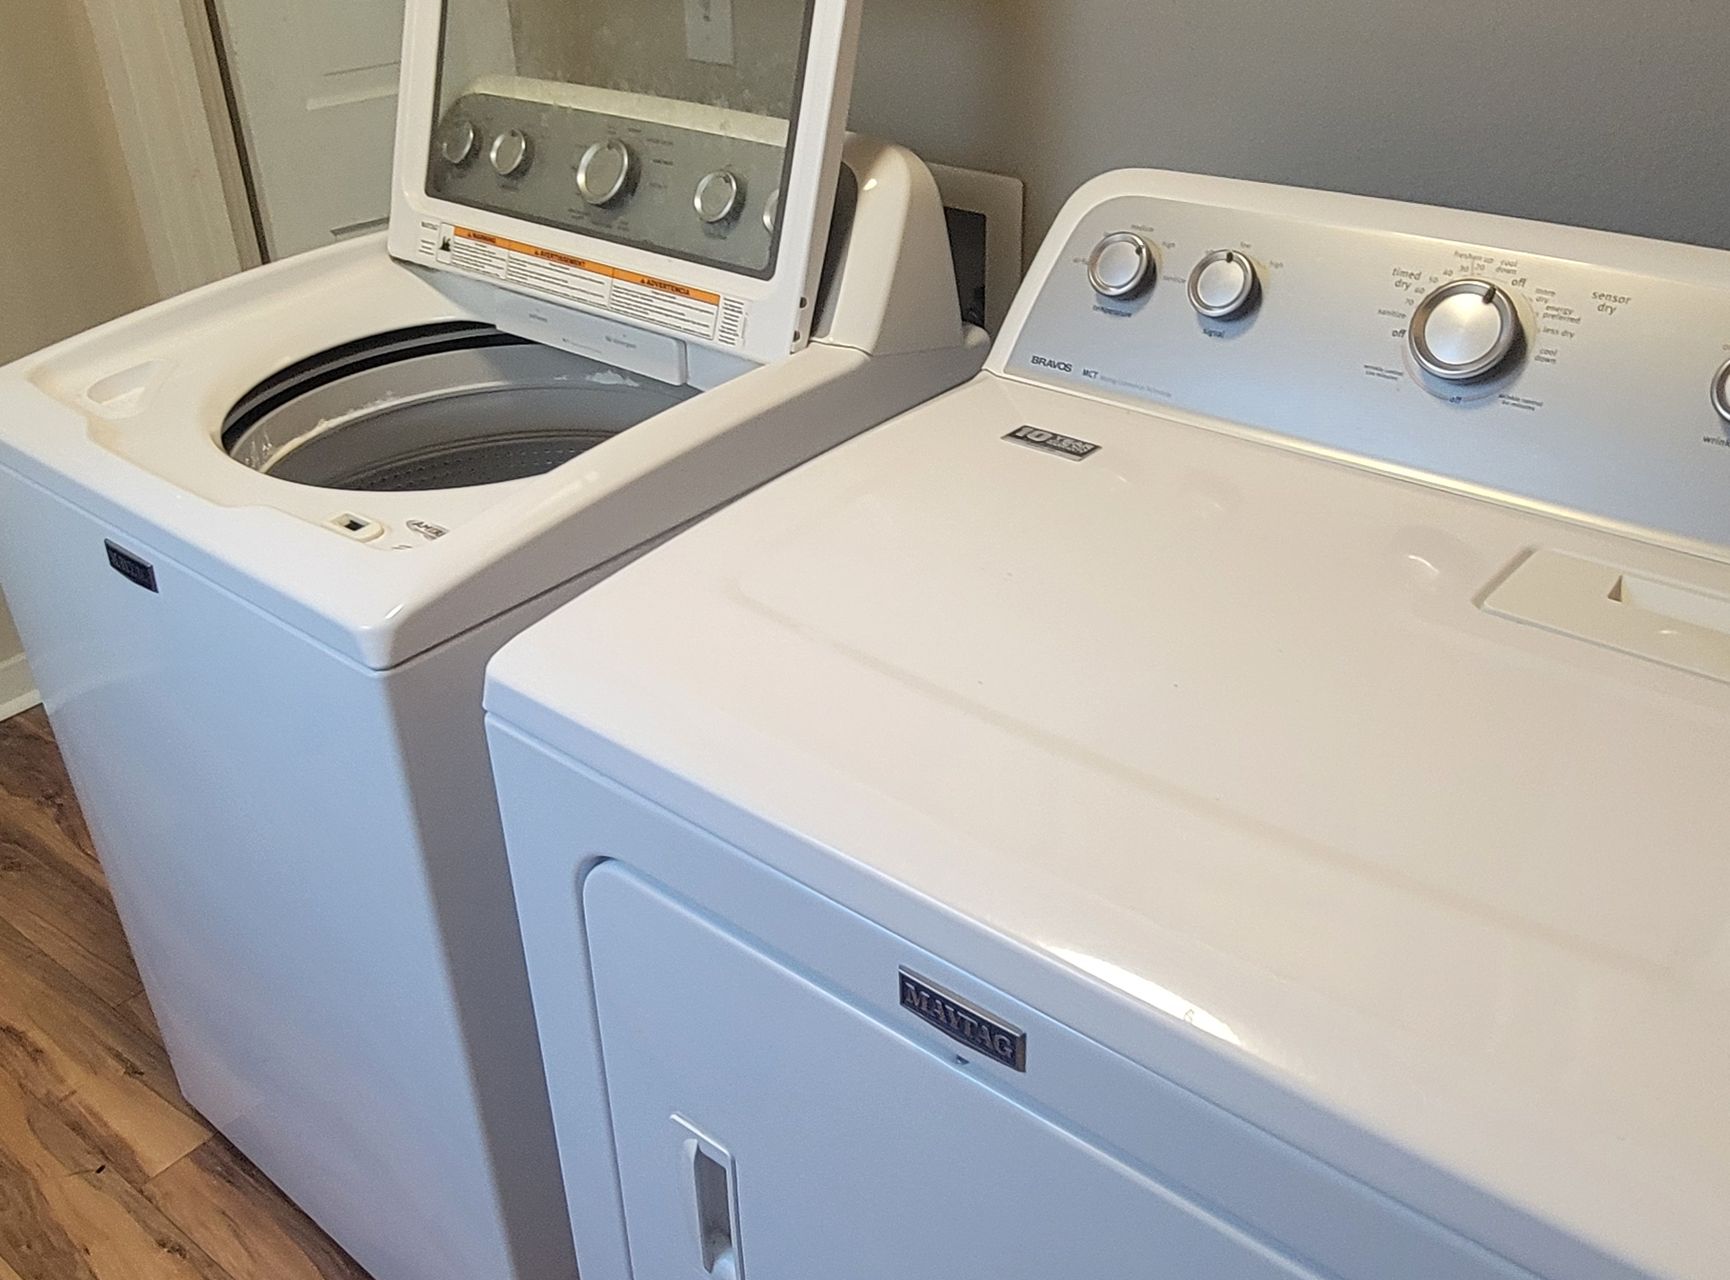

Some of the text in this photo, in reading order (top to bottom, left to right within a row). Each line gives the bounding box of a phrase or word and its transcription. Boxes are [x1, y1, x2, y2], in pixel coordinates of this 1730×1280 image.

[1391, 267, 1422, 281] timed
[647, 279, 691, 296] ADVERTENCIA
[1394, 279, 1412, 291] dry
[1511, 278, 1527, 288] off
[1591, 291, 1632, 305] sensor
[1545, 305, 1575, 316] energy
[1597, 303, 1617, 316] dry
[1542, 312, 1582, 325] preferred
[1391, 329, 1407, 338] off
[1561, 329, 1575, 338] dry
[1031, 355, 1073, 372] BRAVOS
[903, 981, 1015, 1059] MAYTAG
